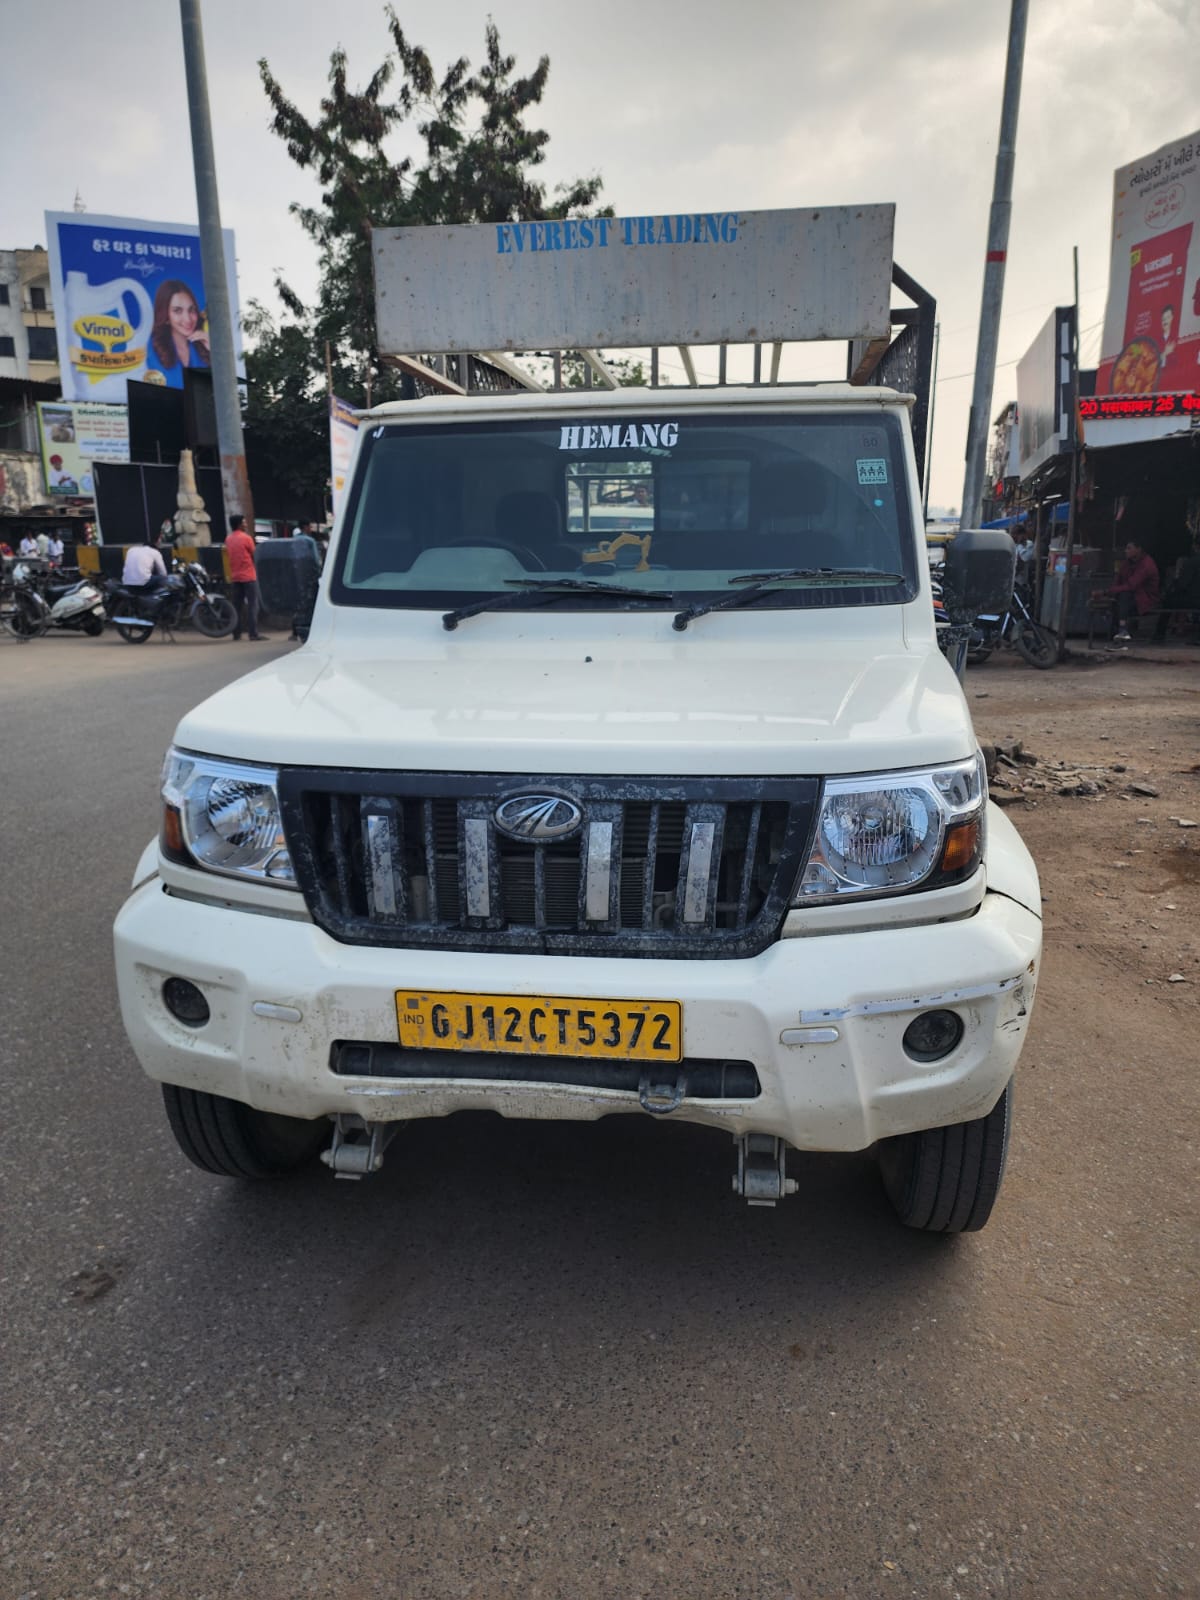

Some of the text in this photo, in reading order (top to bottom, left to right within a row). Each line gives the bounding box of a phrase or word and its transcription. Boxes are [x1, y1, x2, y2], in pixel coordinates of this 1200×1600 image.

[497, 213, 739, 253] EVEREST TRADING
[92, 239, 110, 252] હર
[113, 240, 132, 254] ઘર
[135, 242, 148, 255] કા
[82, 321, 125, 337] Vimal
[1080, 401, 1097, 415] 20
[1155, 397, 1175, 411] 25
[559, 422, 679, 451] HEMANG
[403, 1013, 425, 1025] IND
[431, 1004, 672, 1051] GJ12CT5372
